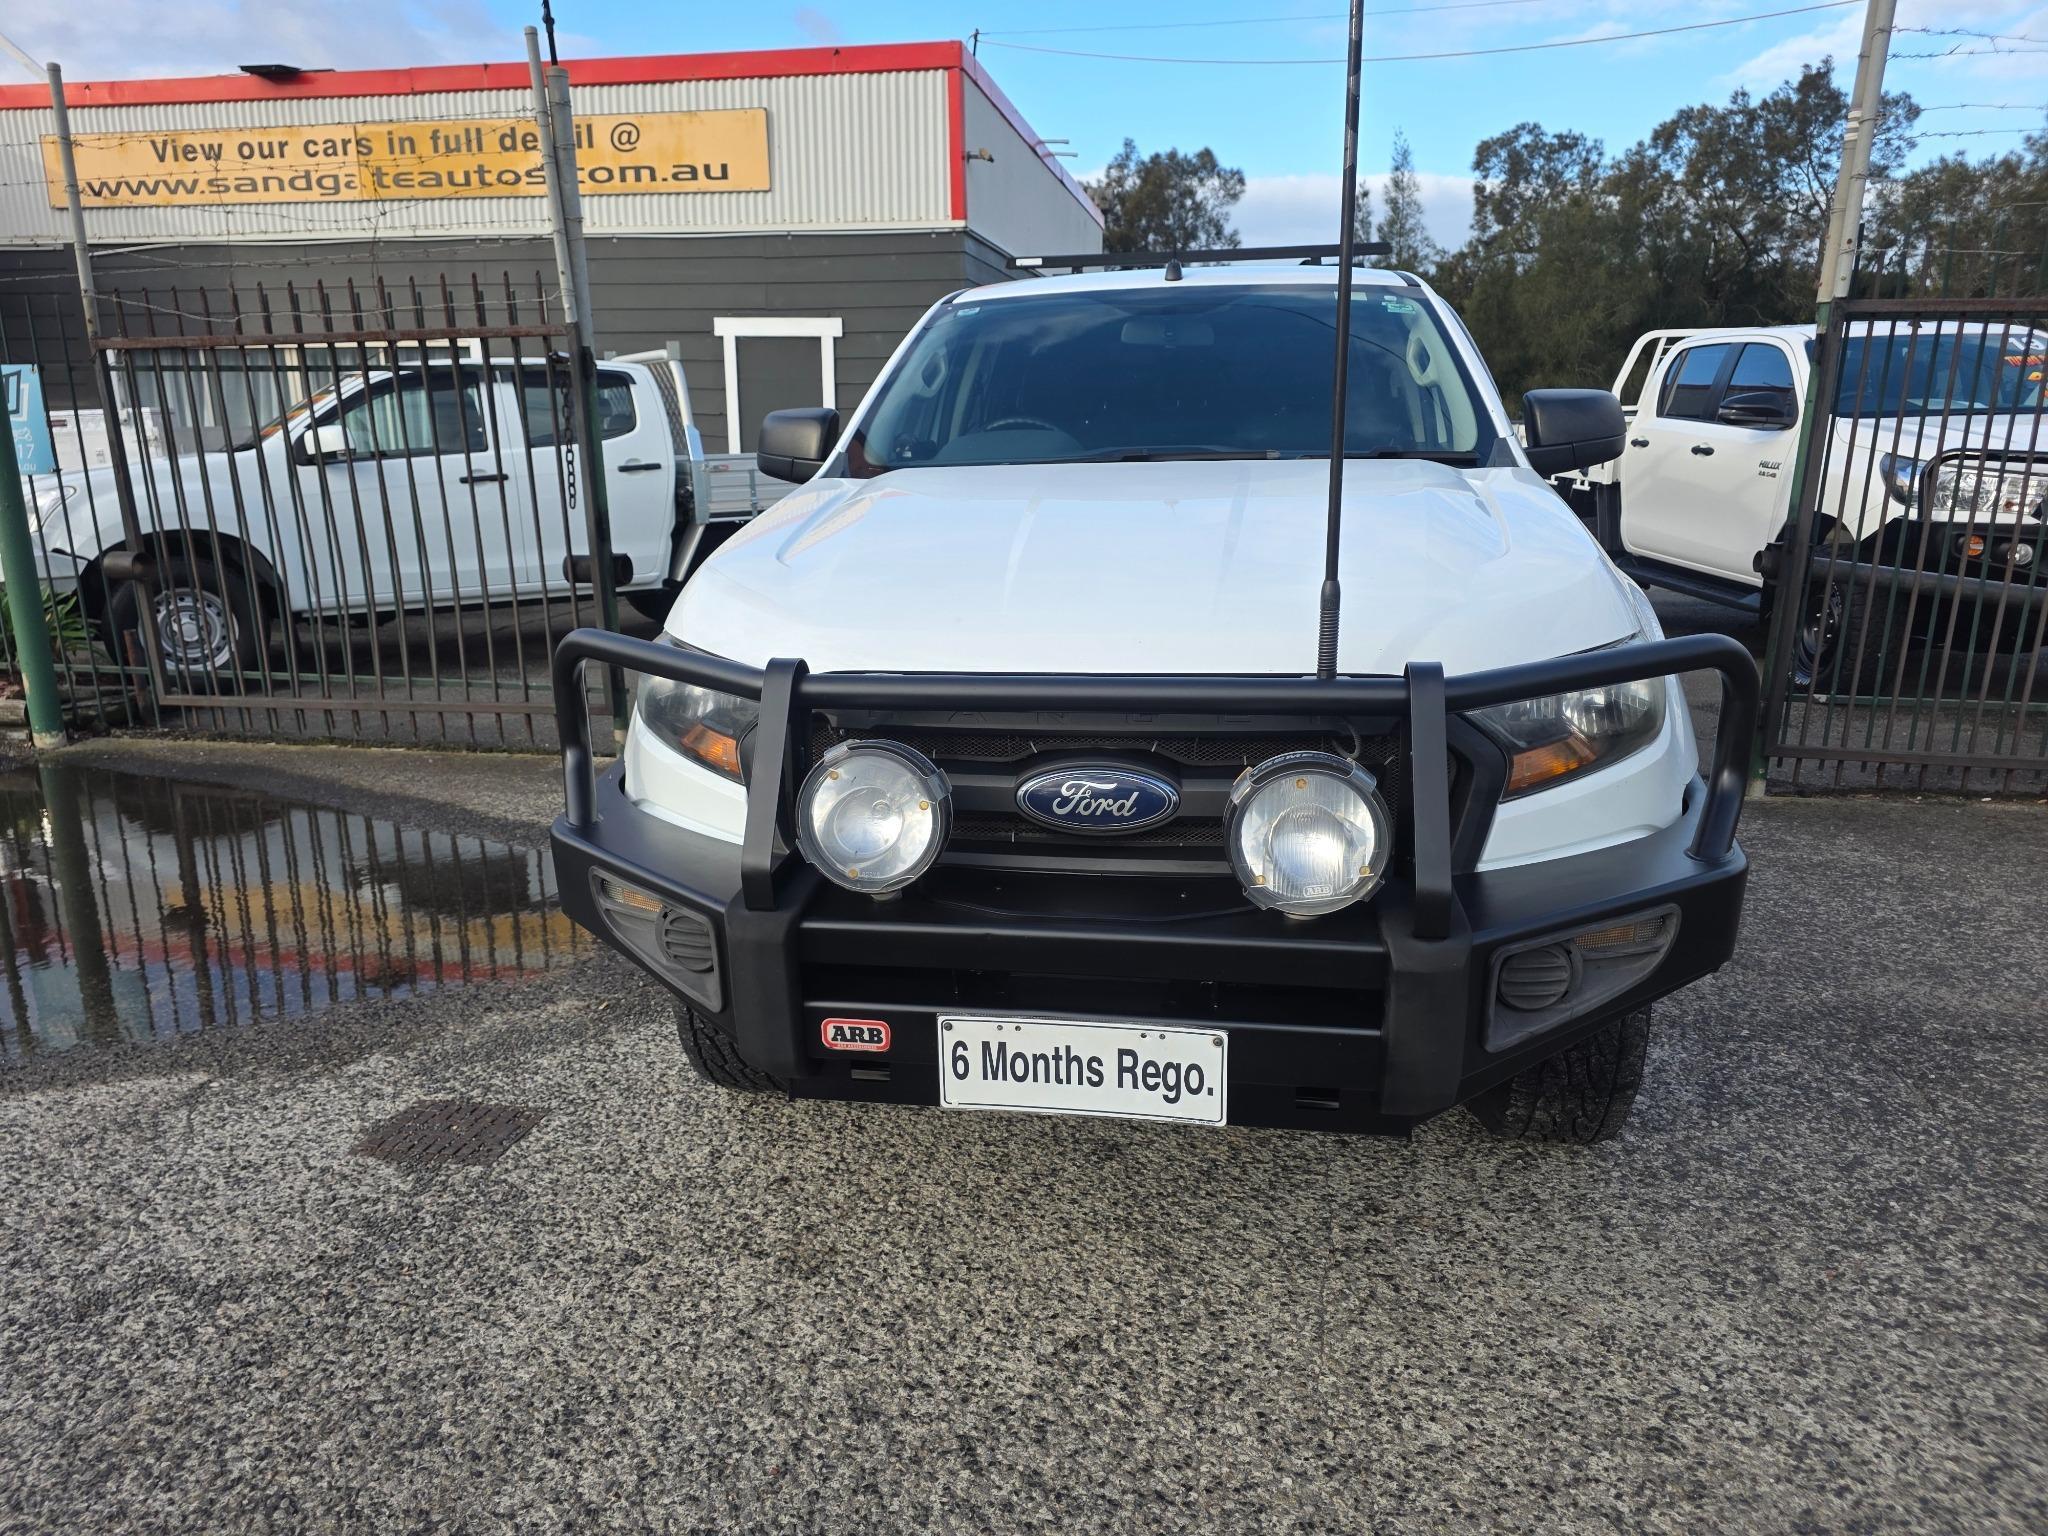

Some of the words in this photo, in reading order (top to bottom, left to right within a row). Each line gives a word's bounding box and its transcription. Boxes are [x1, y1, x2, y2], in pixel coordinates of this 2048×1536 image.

[150, 139, 223, 163] View
[237, 140, 289, 159] our
[303, 136, 373, 158] cars
[387, 130, 416, 155] in
[430, 127, 484, 153] full
[499, 124, 594, 151] deil
[610, 122, 640, 152] @
[1759, 460, 1782, 470] HILUX
[1052, 780, 1139, 817] Ford
[1306, 886, 1330, 896] ARB
[831, 1025, 884, 1044] ARB
[951, 1040, 970, 1080] 6
[981, 1041, 1105, 1088] Months
[1117, 1048, 1214, 1104] Rego.
